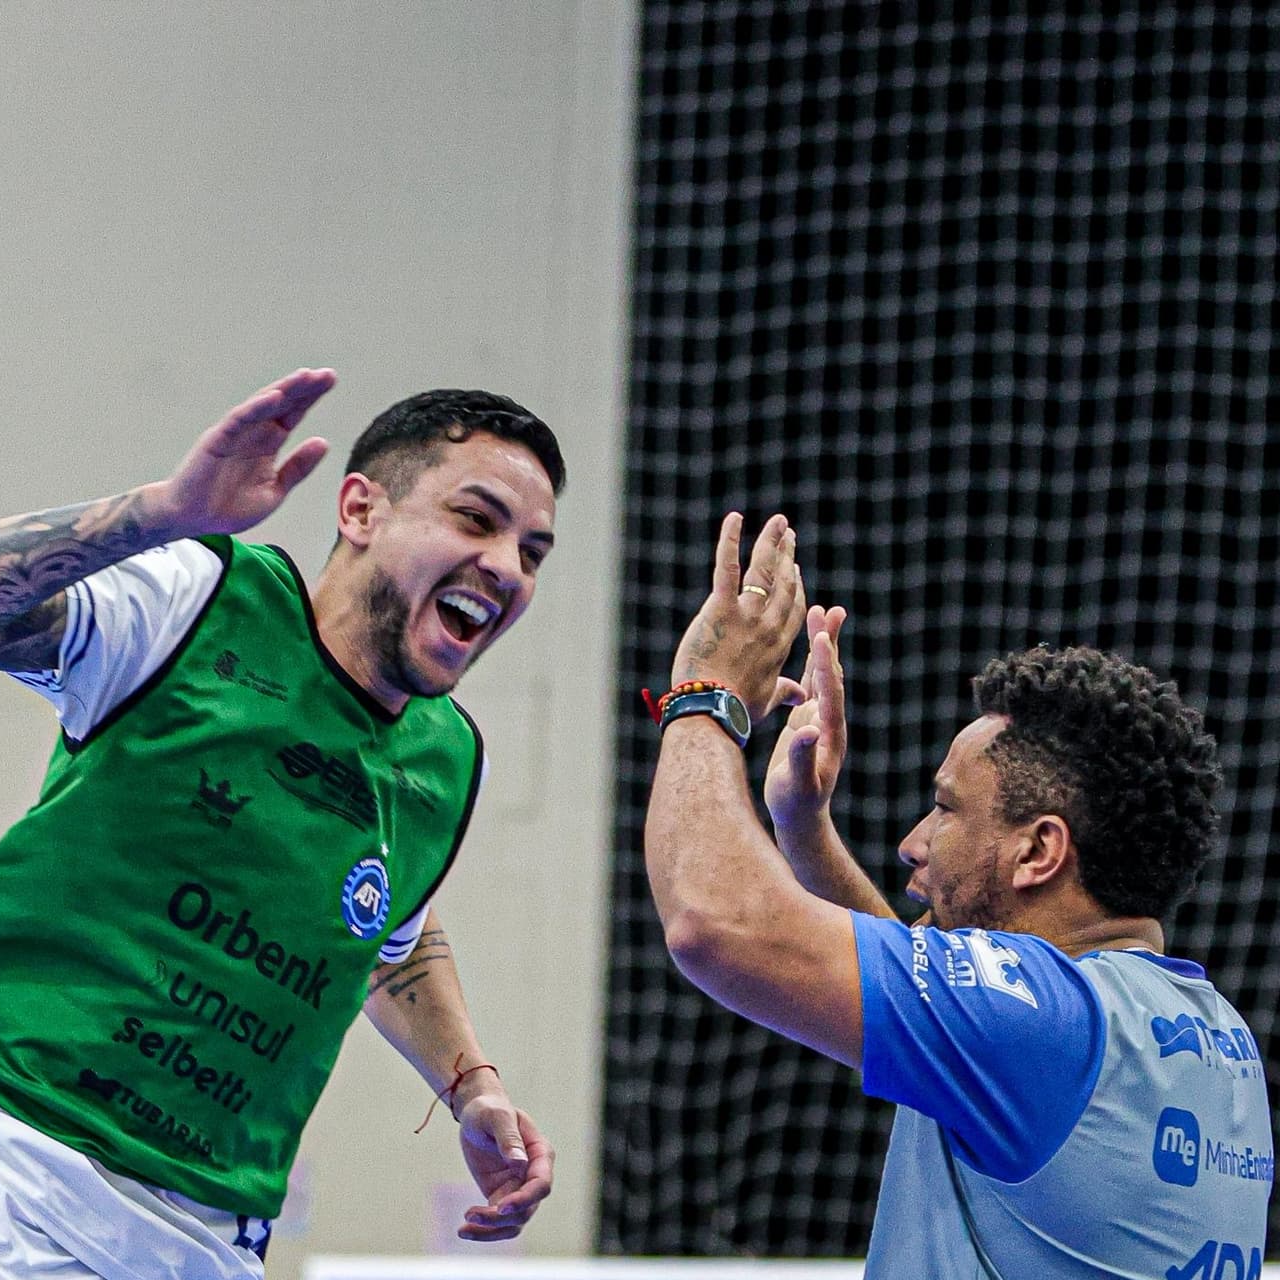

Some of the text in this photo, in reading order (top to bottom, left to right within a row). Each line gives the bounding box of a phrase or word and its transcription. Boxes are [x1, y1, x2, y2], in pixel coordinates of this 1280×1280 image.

[168, 882, 332, 1010] Orbenk
[111, 1015, 253, 1115] selbetti
[168, 970, 296, 1064] unisul
